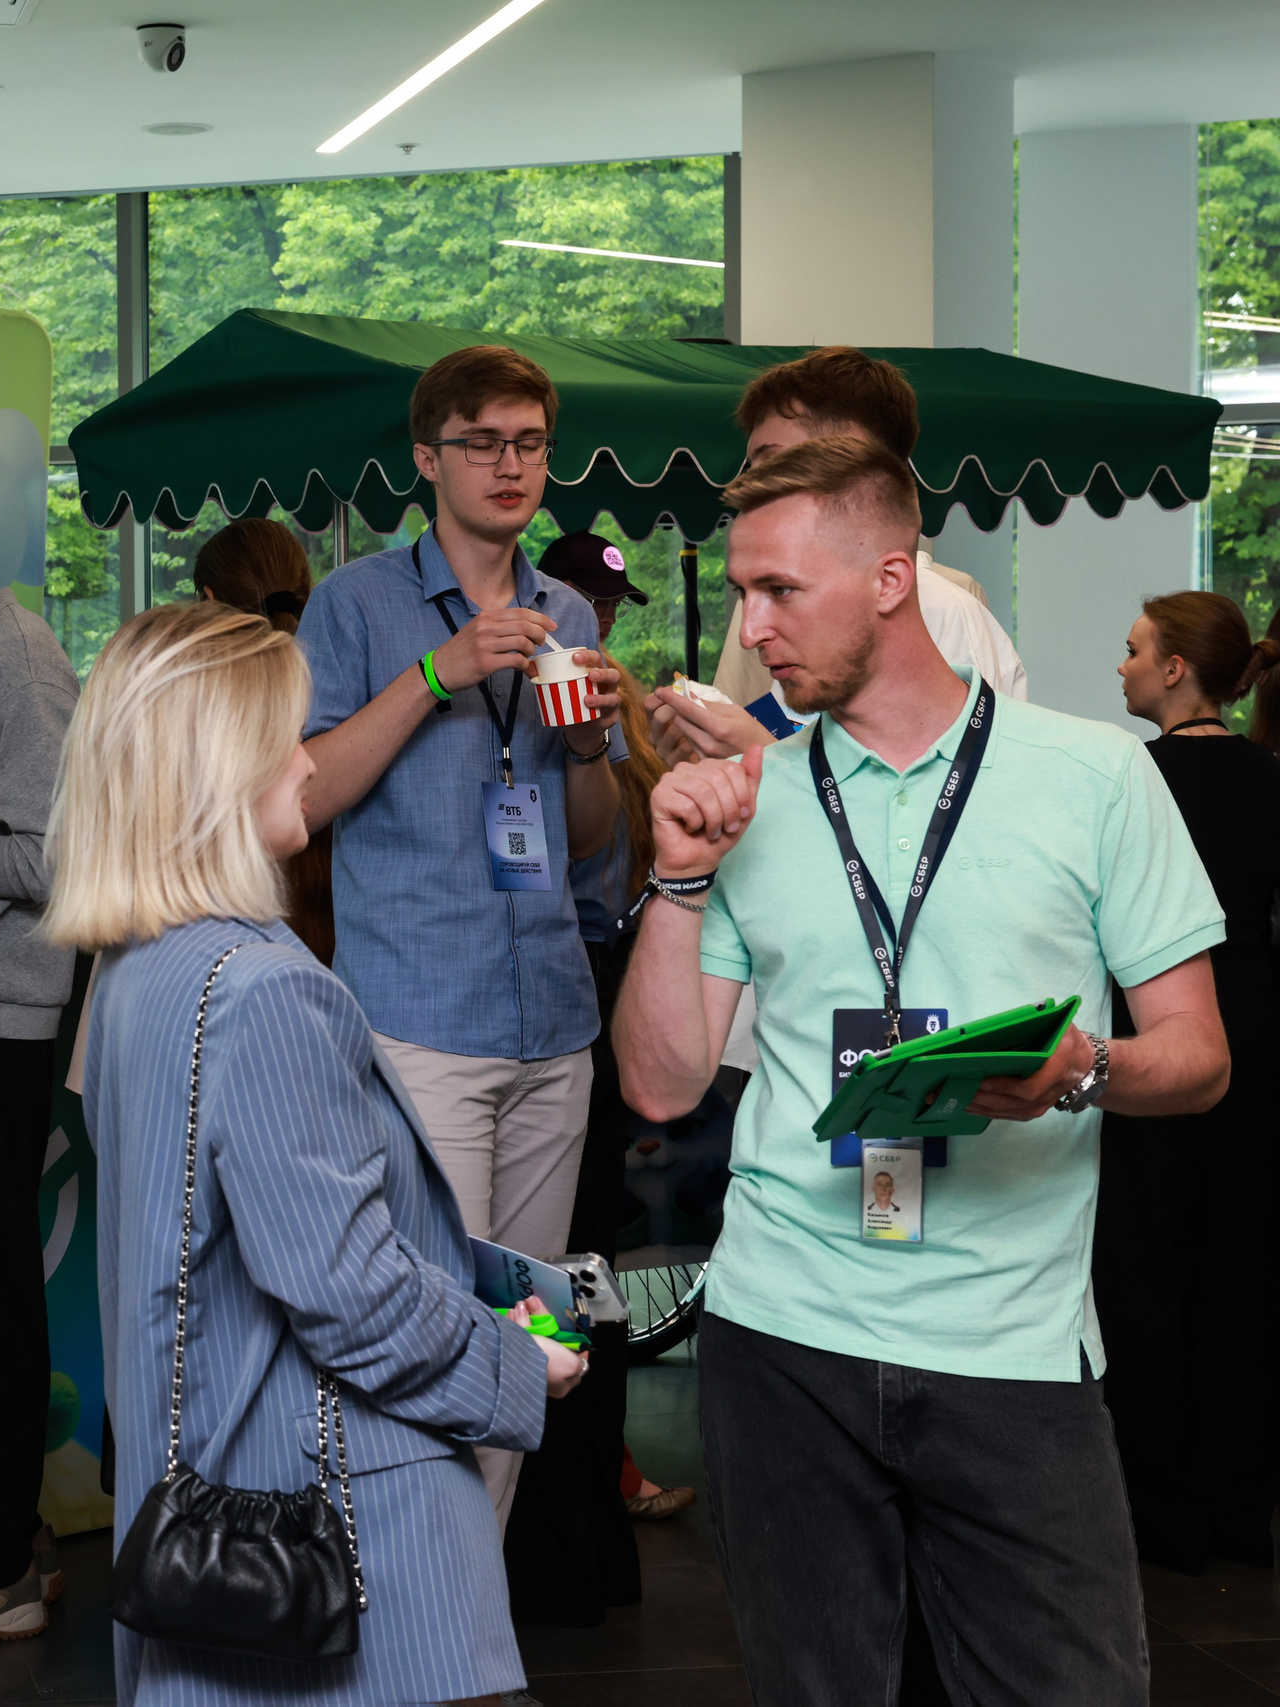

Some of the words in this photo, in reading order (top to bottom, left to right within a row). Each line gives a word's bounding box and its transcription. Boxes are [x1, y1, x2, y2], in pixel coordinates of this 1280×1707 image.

[944, 770, 961, 797] СБЕР
[505, 806, 522, 816] ВТБ
[826, 789, 841, 814] СБЕР
[916, 856, 929, 883] СБЕР
[851, 873, 866, 900] СБЕР
[880, 961, 895, 988] СБЕР
[879, 1155, 901, 1163] СБЕР
